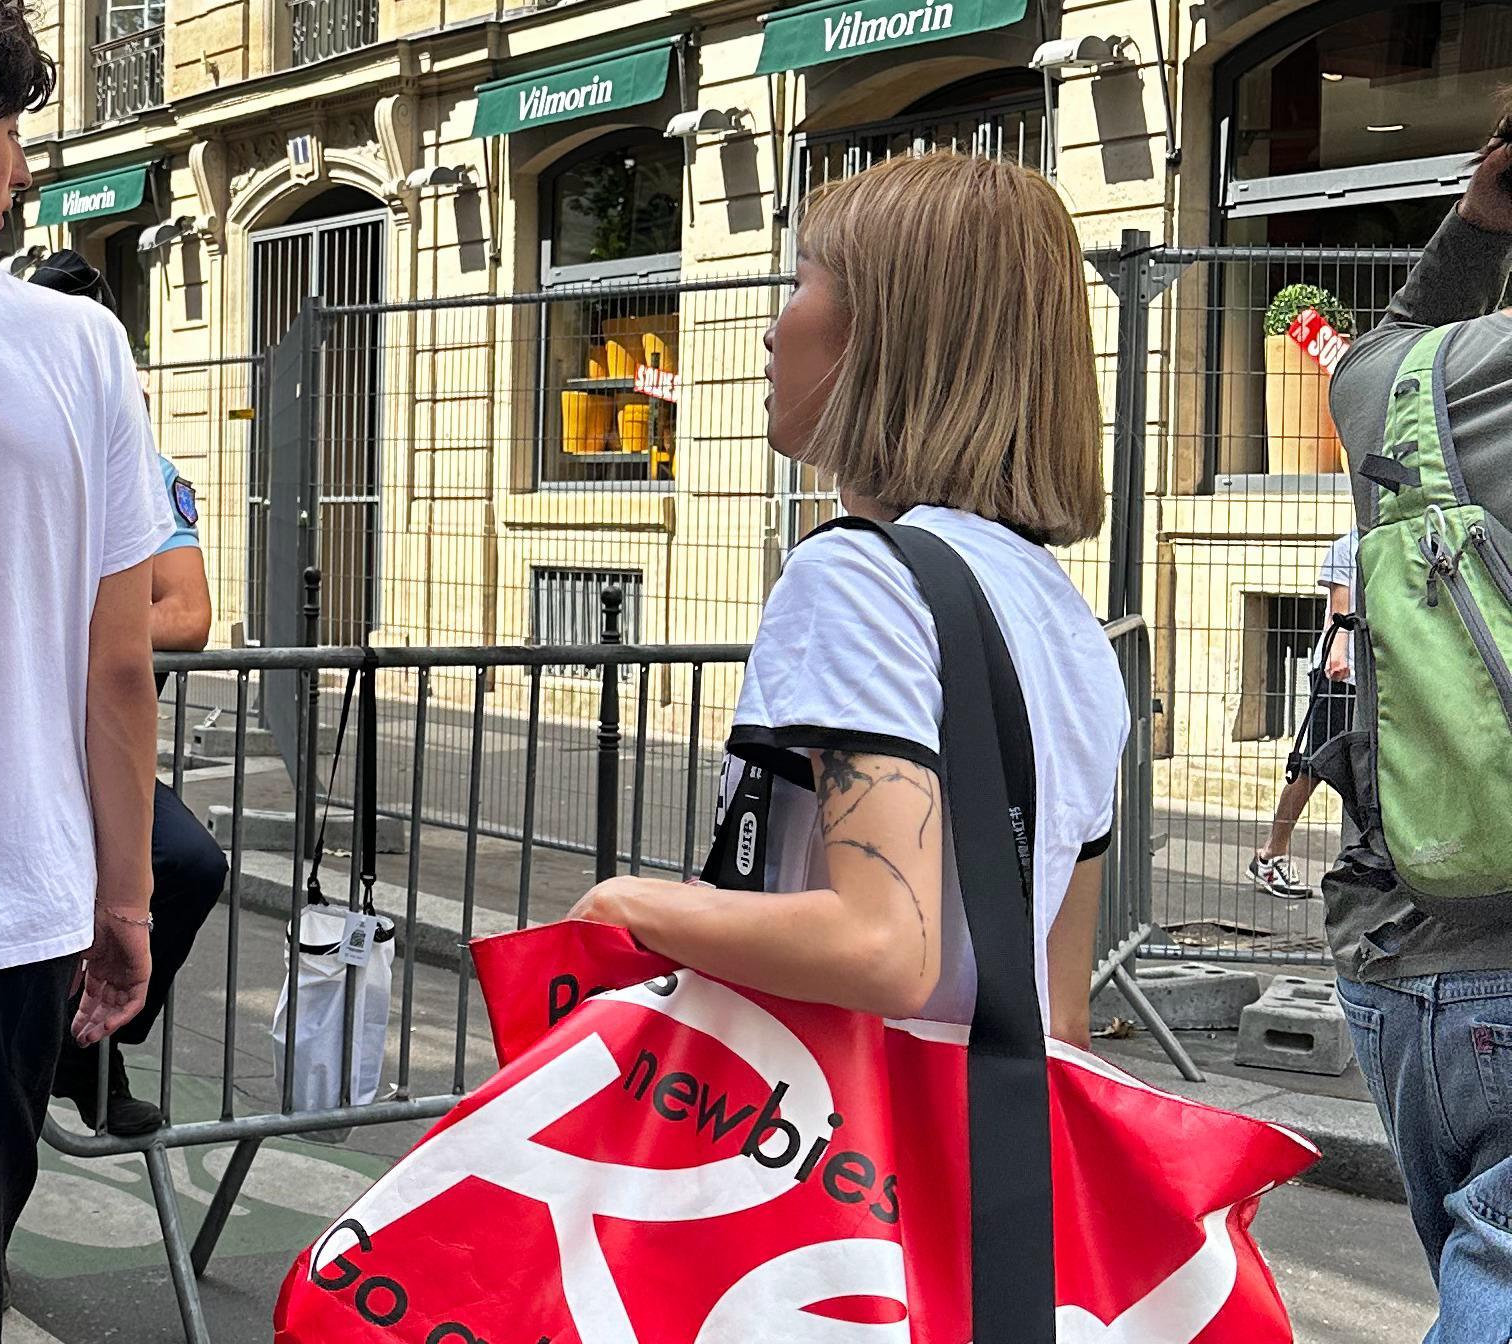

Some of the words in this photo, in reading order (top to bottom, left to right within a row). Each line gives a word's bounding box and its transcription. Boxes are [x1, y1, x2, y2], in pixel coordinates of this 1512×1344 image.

[519, 75, 613, 122] Vilmorin
[62, 185, 116, 216] Vilmorin
[622, 1048, 901, 1225] newbies
[310, 1218, 408, 1327] Go
